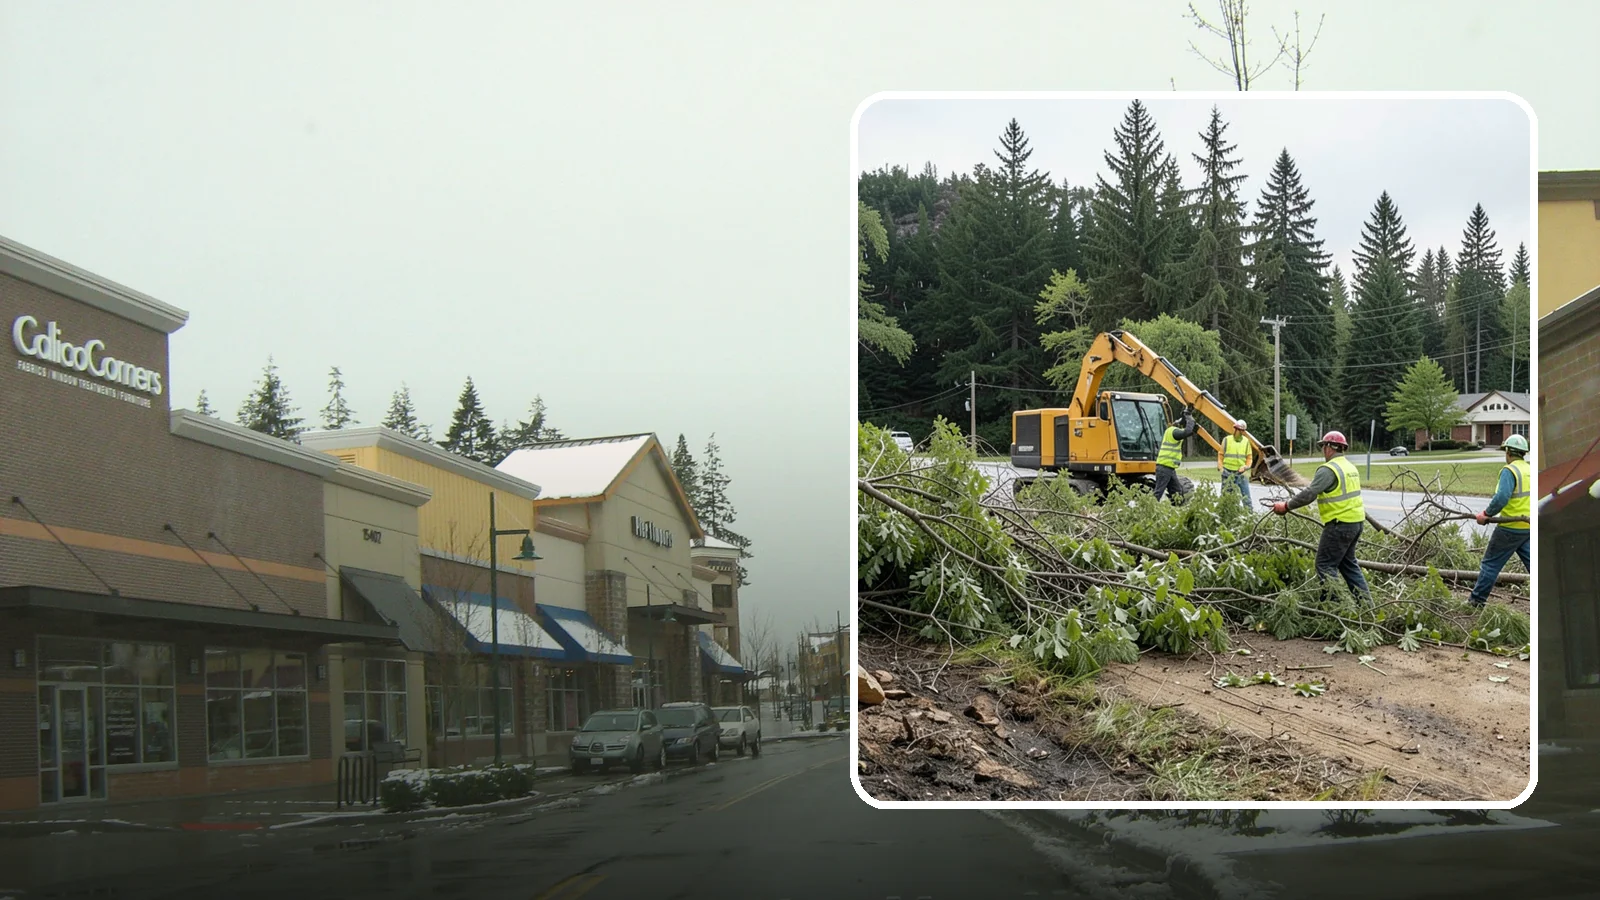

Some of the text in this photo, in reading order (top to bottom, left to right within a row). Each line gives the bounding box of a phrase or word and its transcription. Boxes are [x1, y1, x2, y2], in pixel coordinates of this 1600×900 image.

[17, 360, 151, 409] FABRICS WINDOW TREATMENTS FURNITURE
